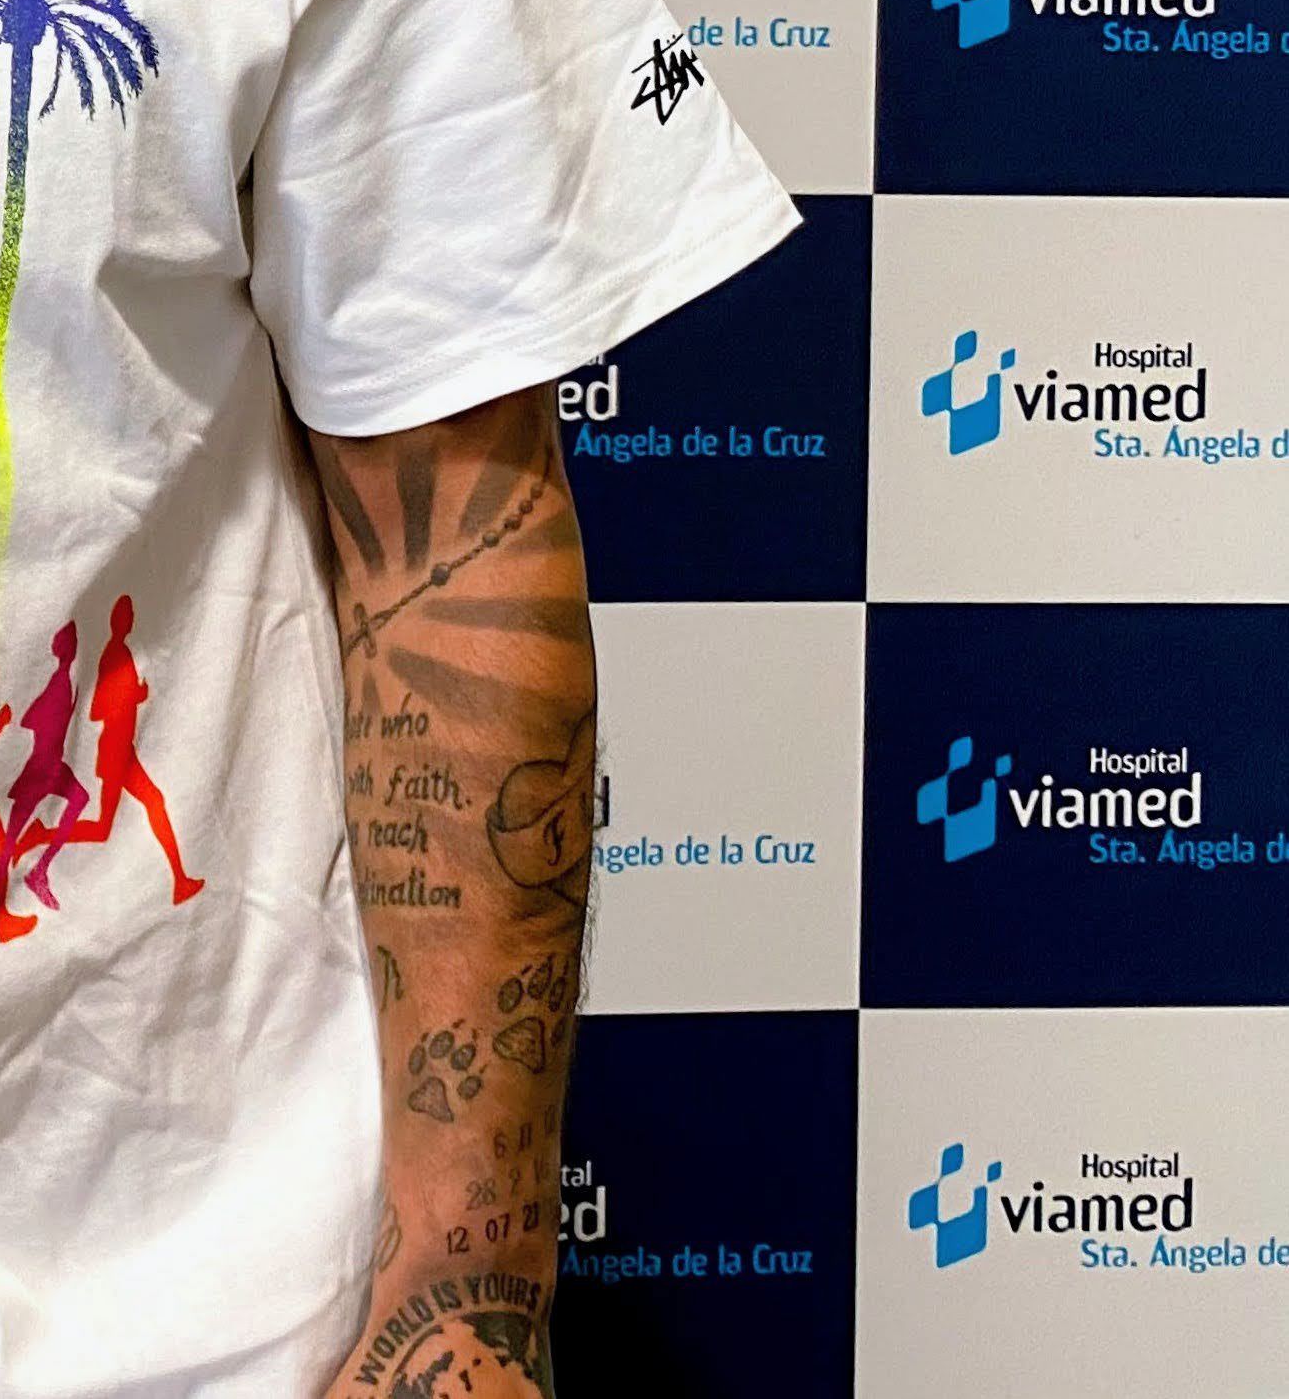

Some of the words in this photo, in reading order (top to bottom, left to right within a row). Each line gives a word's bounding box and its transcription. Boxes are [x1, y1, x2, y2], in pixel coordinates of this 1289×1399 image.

[687, 19, 724, 48] de
[734, 18, 759, 47] la
[769, 17, 830, 48] Cruz
[1102, 21, 1160, 52] Sta.
[1171, 20, 1270, 59] Ángela
[1095, 342, 1193, 374] Hospital
[1013, 367, 1207, 423] viamed
[574, 423, 672, 463] Ángela
[682, 427, 719, 456] de
[729, 426, 753, 457] la
[762, 426, 825, 457] Cruz
[1094, 427, 1151, 458] Sta.
[1164, 427, 1261, 465] Ángela
[1090, 746, 1188, 779] Hospital
[1008, 771, 1202, 829] viamed
[676, 840, 711, 864] de
[719, 840, 745, 866] la
[753, 835, 815, 866] Cruz
[1089, 832, 1146, 864] Sta.
[1158, 829, 1256, 871] Ángela
[1081, 1152, 1179, 1183] Hospital
[1000, 1177, 1193, 1234] viamed
[446, 1227, 470, 1254] 12
[485, 1214, 510, 1242] 07
[1080, 1238, 1138, 1269] Sta.
[1149, 1233, 1247, 1273] Ángela
[564, 1246, 662, 1281] Ángela
[672, 1246, 708, 1277] de
[718, 1244, 742, 1276] la
[752, 1243, 812, 1275] Cruz
[355, 1295, 435, 1386] WORLD
[430, 1280, 462, 1312] IS
[463, 1272, 542, 1312] YOURS
